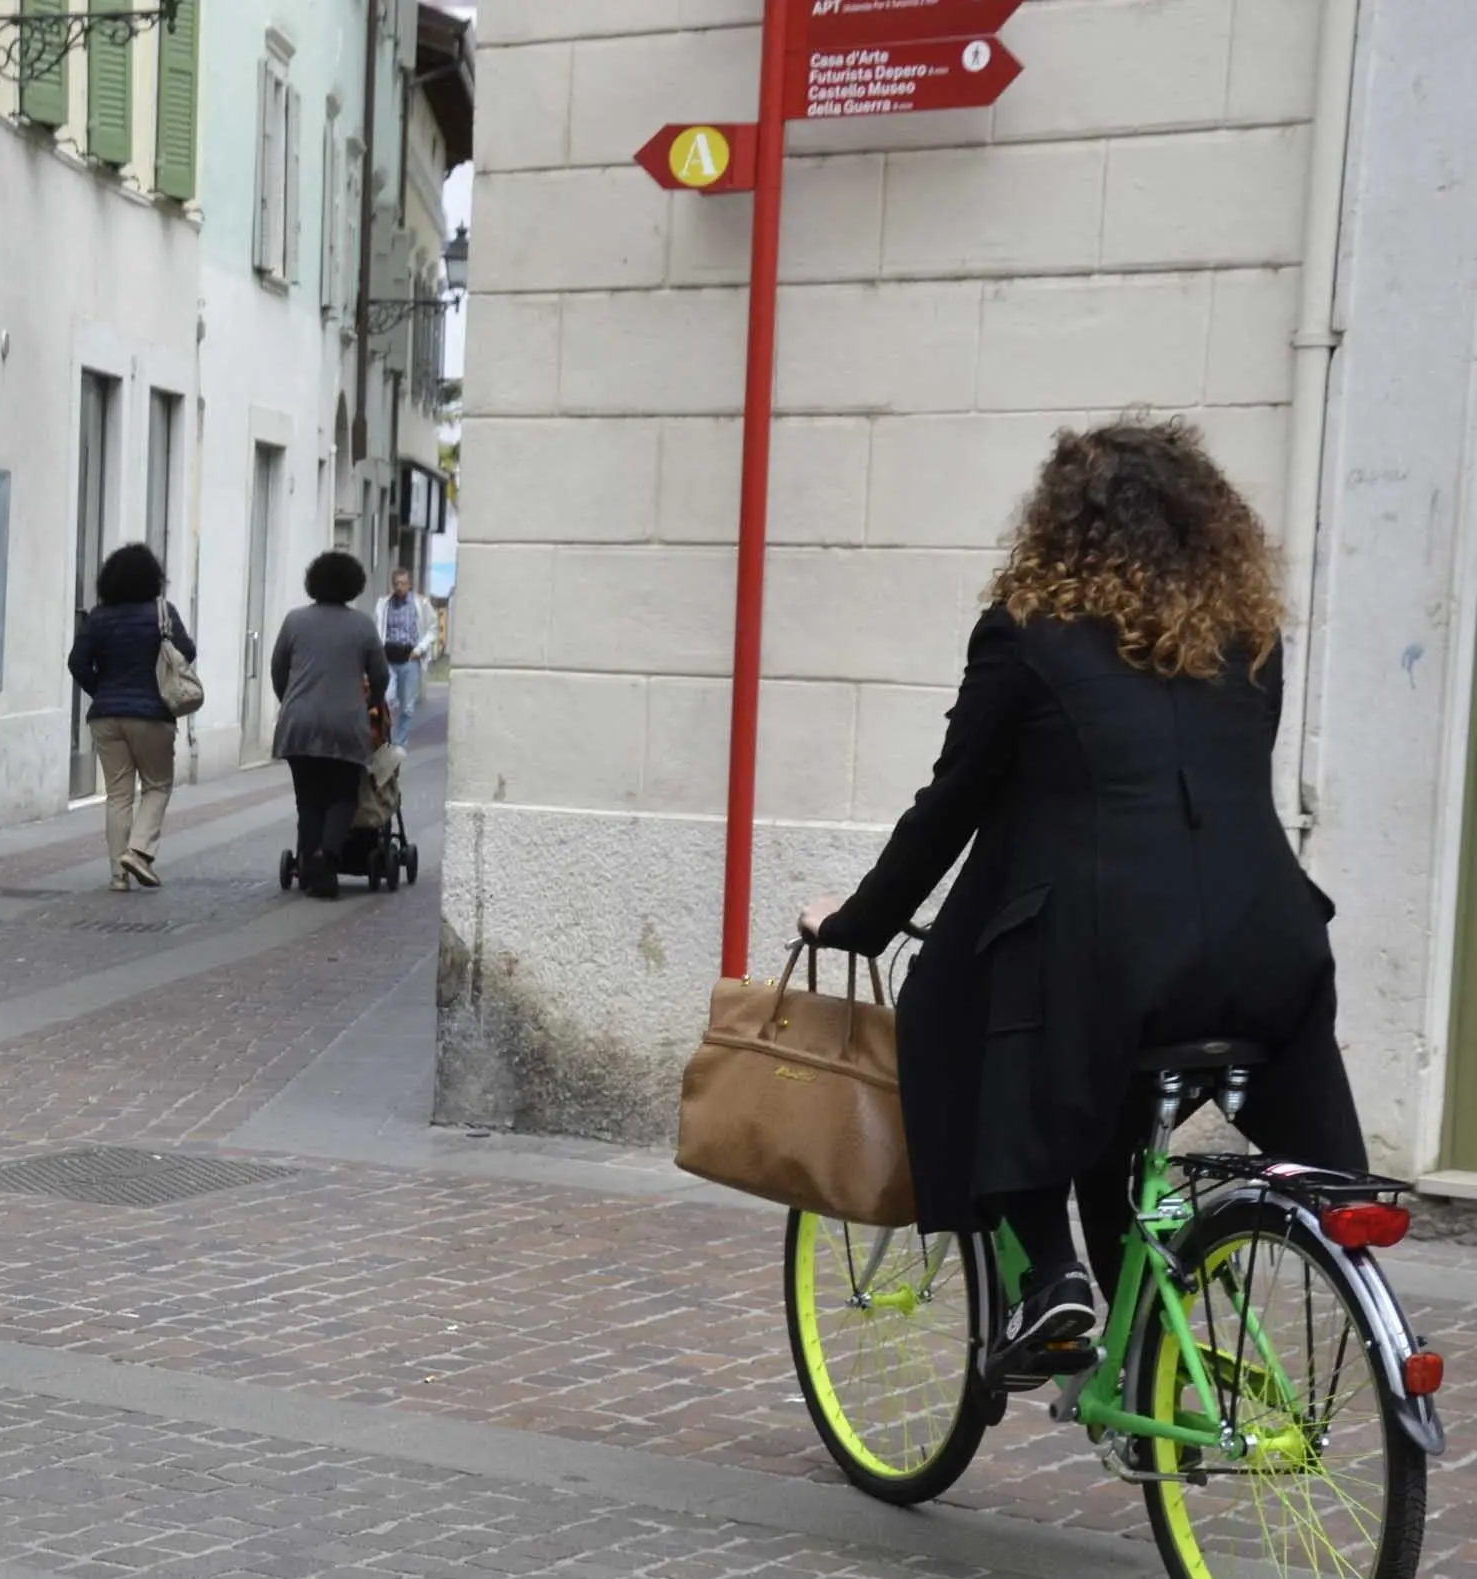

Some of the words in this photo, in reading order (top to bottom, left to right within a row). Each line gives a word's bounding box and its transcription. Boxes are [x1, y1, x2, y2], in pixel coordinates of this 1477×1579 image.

[810, 53, 844, 68] Casa
[846, 51, 889, 66] d'Arte
[809, 67, 872, 84] Futurista
[875, 64, 927, 80] Depero
[808, 83, 865, 101] Castello
[868, 81, 915, 97] Museo
[807, 101, 841, 117] della
[843, 100, 891, 114] Guerra
[678, 133, 718, 176] A
